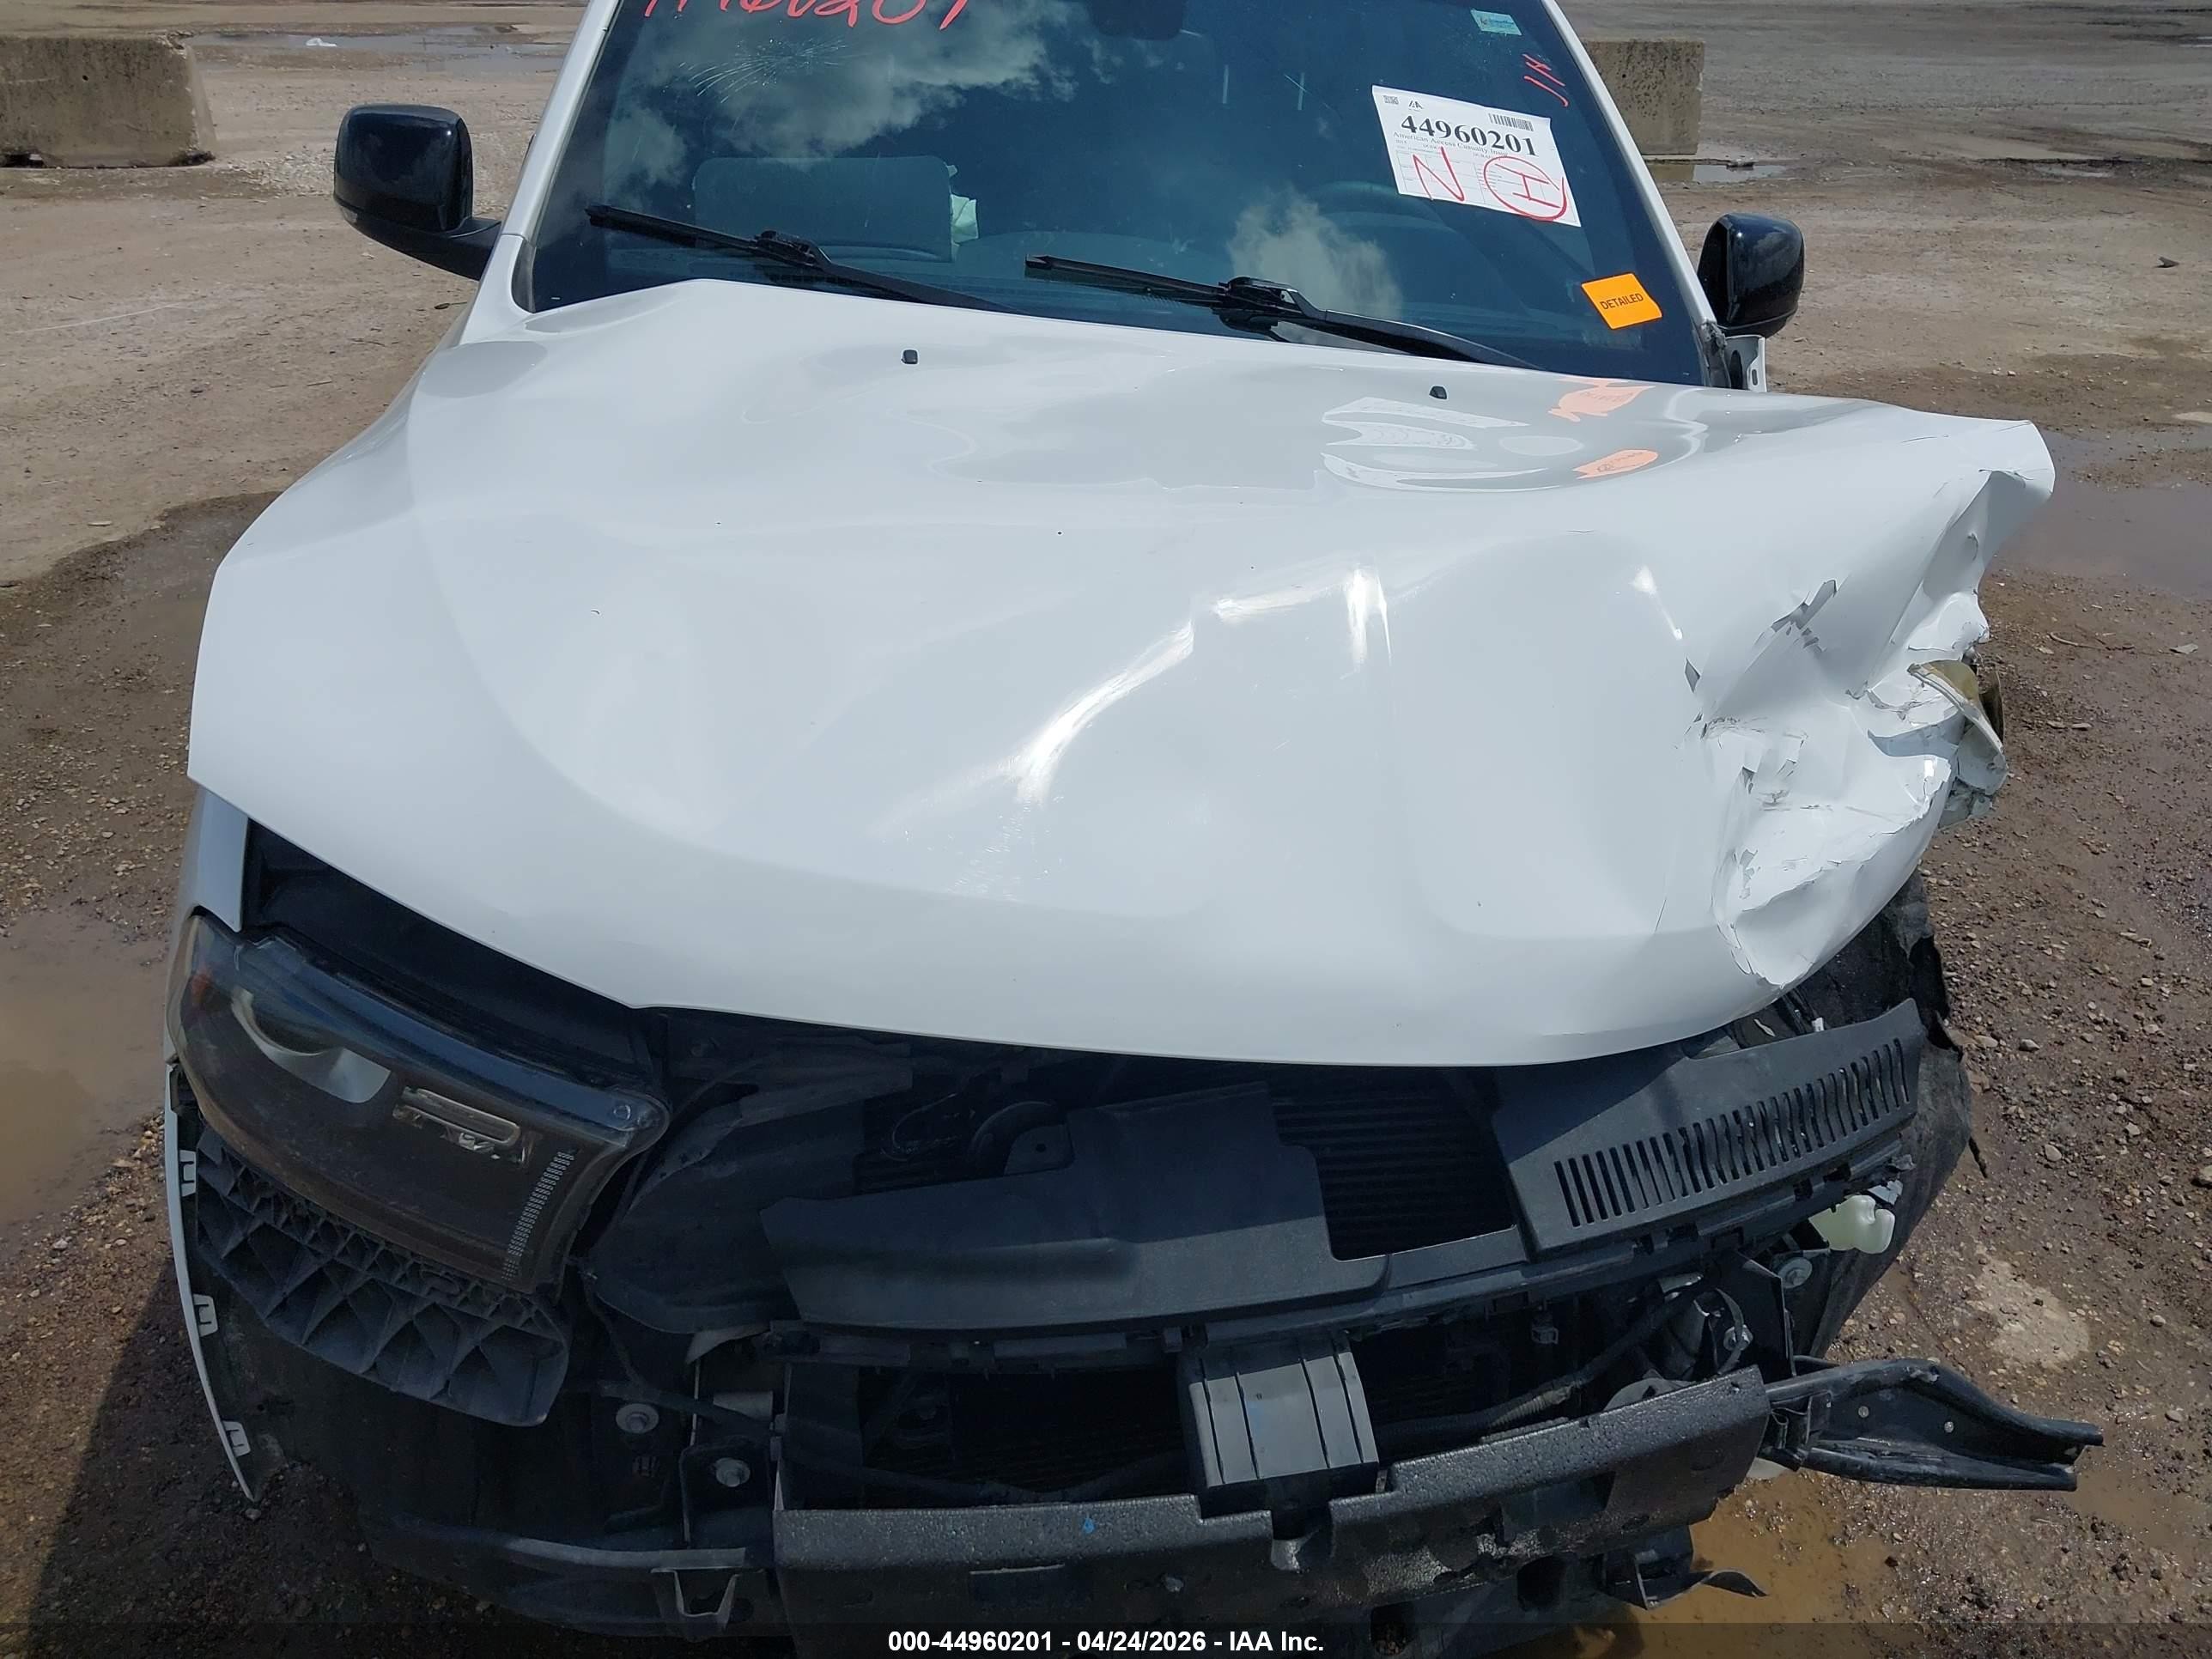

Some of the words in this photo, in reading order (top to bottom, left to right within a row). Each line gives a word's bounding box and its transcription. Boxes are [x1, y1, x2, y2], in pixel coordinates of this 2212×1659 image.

[1394, 131, 1430, 143] American
[1431, 138, 1456, 147] Access
[1401, 115, 1539, 156] 44960201
[1600, 293, 1644, 310] DETAILED
